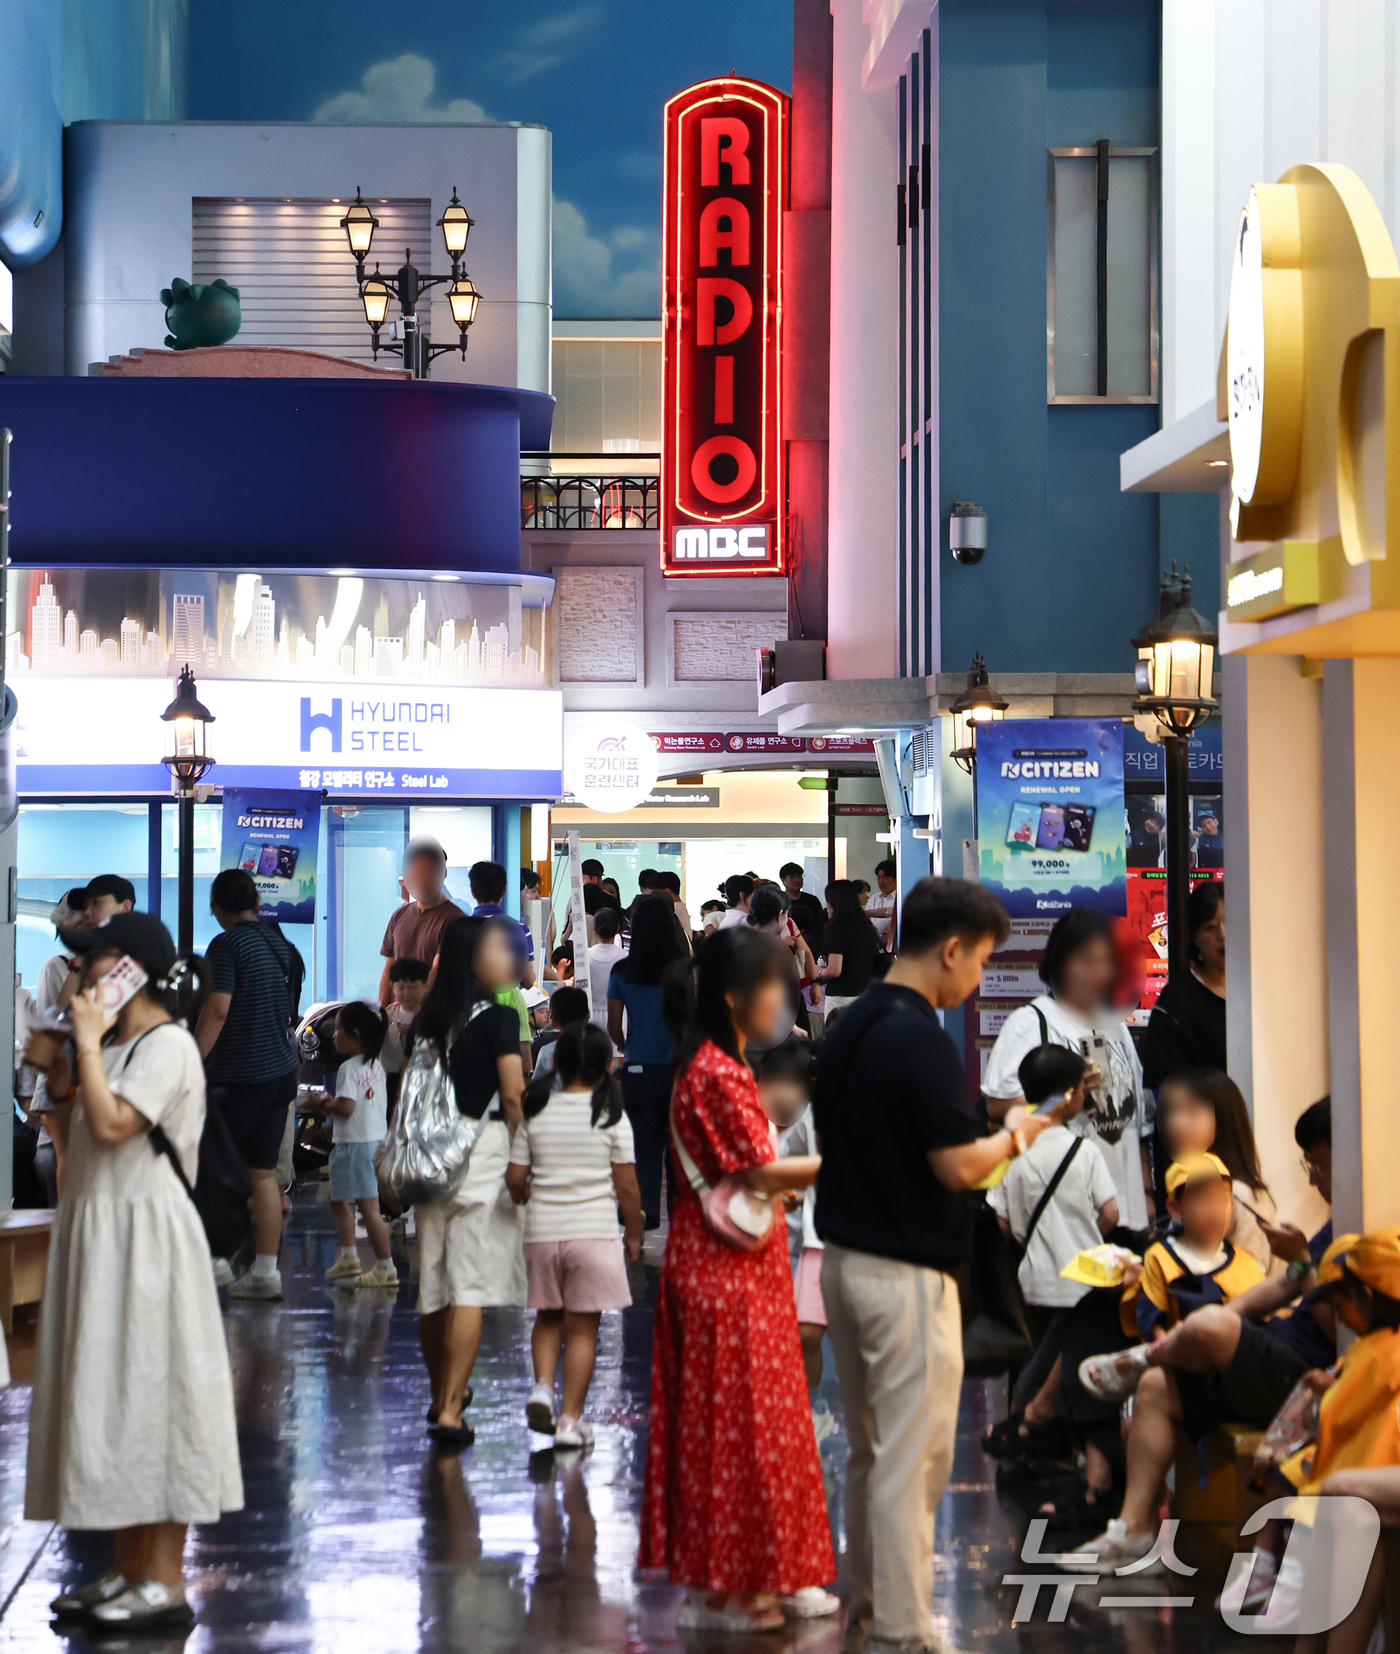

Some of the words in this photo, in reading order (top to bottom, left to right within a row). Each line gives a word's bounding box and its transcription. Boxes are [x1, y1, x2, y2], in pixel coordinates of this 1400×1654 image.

[691, 117, 757, 504] RADIO
[675, 527, 767, 559] MBC
[351, 701, 450, 723] HYUNDAI
[351, 730, 423, 752] STEEL
[663, 736, 705, 746] 먹는물연구소
[746, 736, 766, 746] 유제품
[767, 736, 788, 746] 연구소
[584, 757, 639, 770] 국가대표
[1125, 752, 1158, 770] 직업
[364, 771, 396, 788] 연구소
[401, 773, 427, 788] Steel
[429, 774, 449, 789] Lab
[584, 774, 639, 788] 훈련센터
[1020, 786, 1057, 794] RENEWAL
[1059, 786, 1081, 794] OPEN
